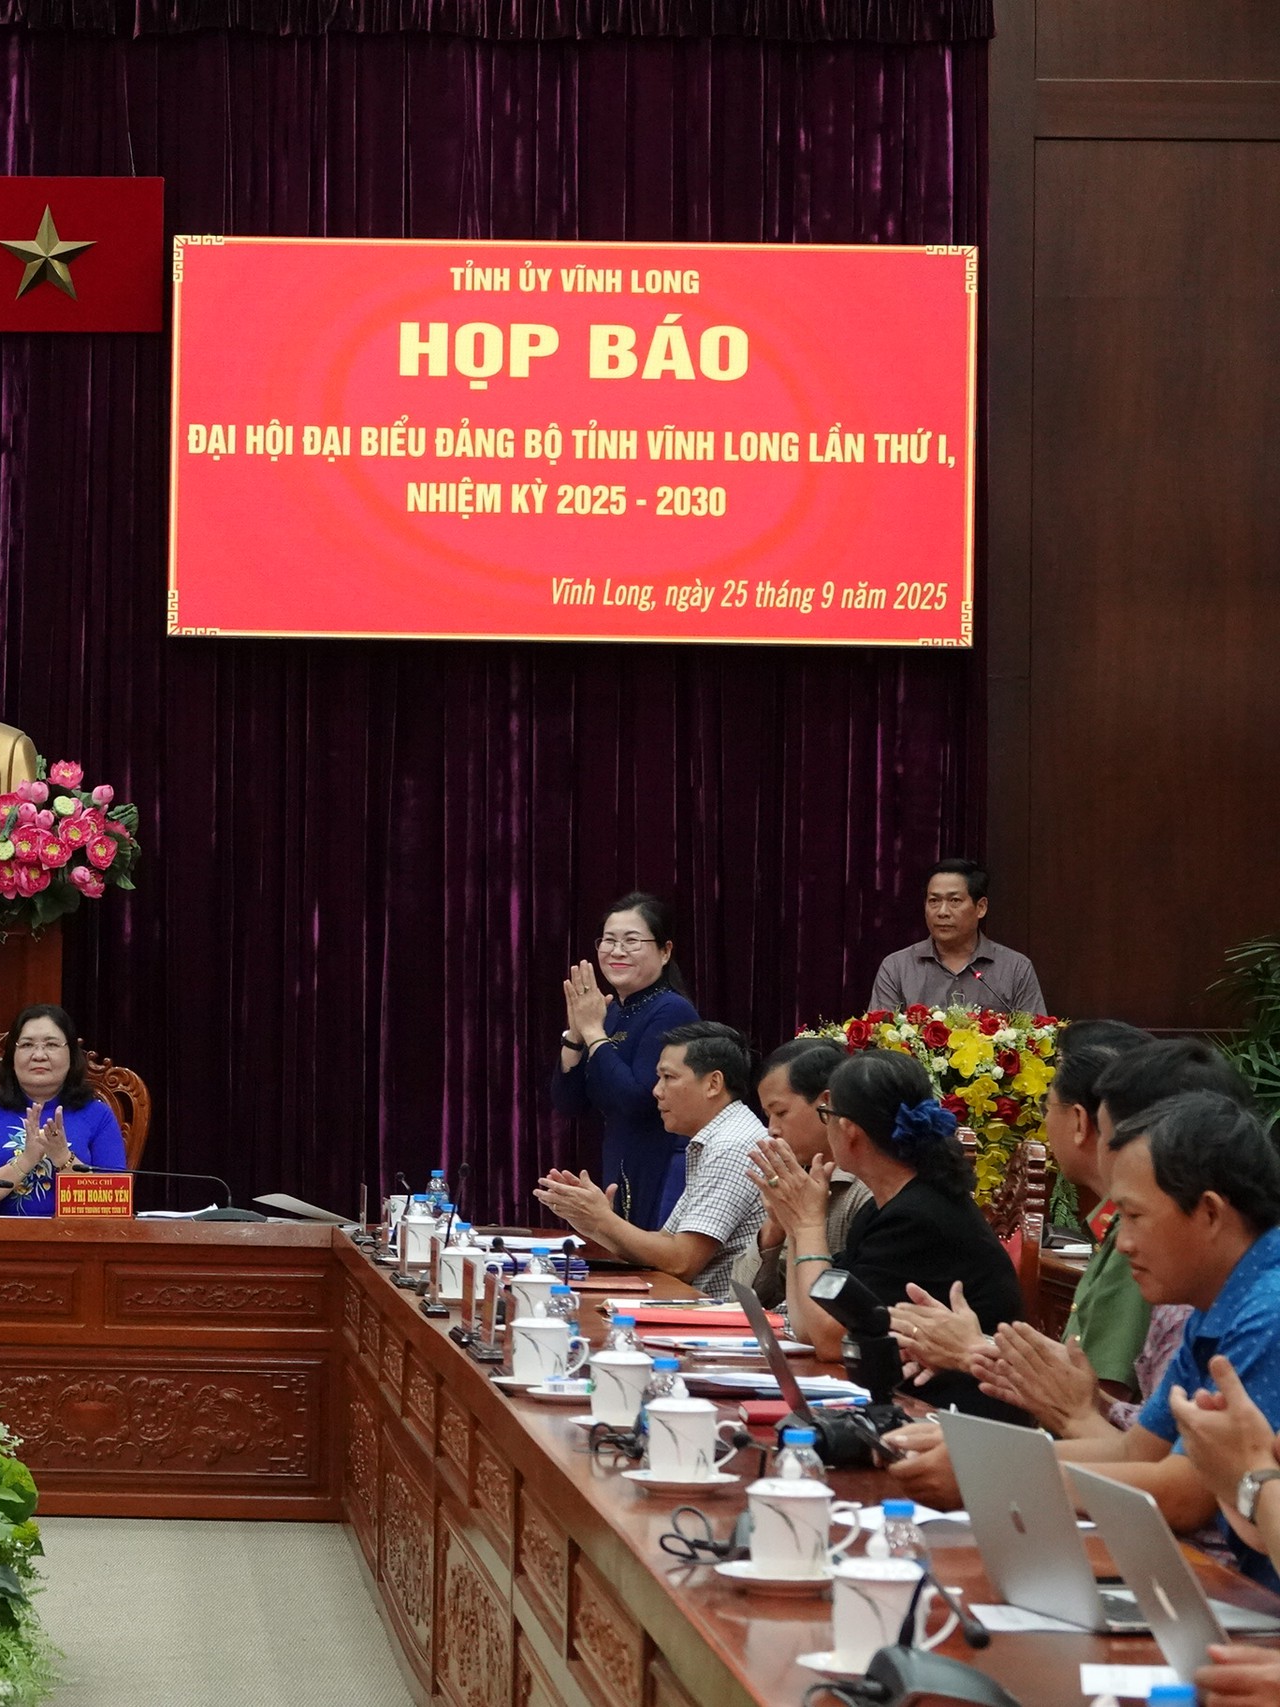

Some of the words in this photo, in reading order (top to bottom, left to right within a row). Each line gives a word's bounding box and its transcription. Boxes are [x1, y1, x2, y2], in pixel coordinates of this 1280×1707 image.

[450, 260, 509, 291] TỈNH
[520, 260, 552, 291] ỦY
[561, 264, 621, 292] VĨNH
[632, 270, 699, 293] LONG
[400, 322, 559, 389] HỌP
[590, 314, 748, 380] BÁO
[188, 424, 235, 460] ĐẠI
[246, 419, 293, 461] HỘI
[303, 426, 350, 462] ĐẠI
[361, 415, 425, 457] BIỂU
[435, 418, 514, 458] ĐẢNG
[525, 423, 562, 465] BỘ
[572, 420, 637, 459] TỈNH
[647, 425, 714, 460] VĨNH
[725, 432, 799, 462] LONG
[810, 423, 864, 462] LẦN
[874, 428, 932, 463] THỨ
[939, 435, 956, 467] I,
[408, 477, 501, 519] NHIỆM
[512, 477, 547, 513] KỲ
[557, 485, 626, 515] 2025
[657, 486, 725, 516] 2030
[553, 578, 595, 604] Vĩnh
[603, 579, 655, 611] Long,
[666, 579, 715, 612] ngày
[721, 580, 747, 607] 25
[756, 580, 815, 613] tháng
[822, 581, 834, 608] 9
[842, 582, 886, 608] năm
[894, 582, 947, 610] 2025
